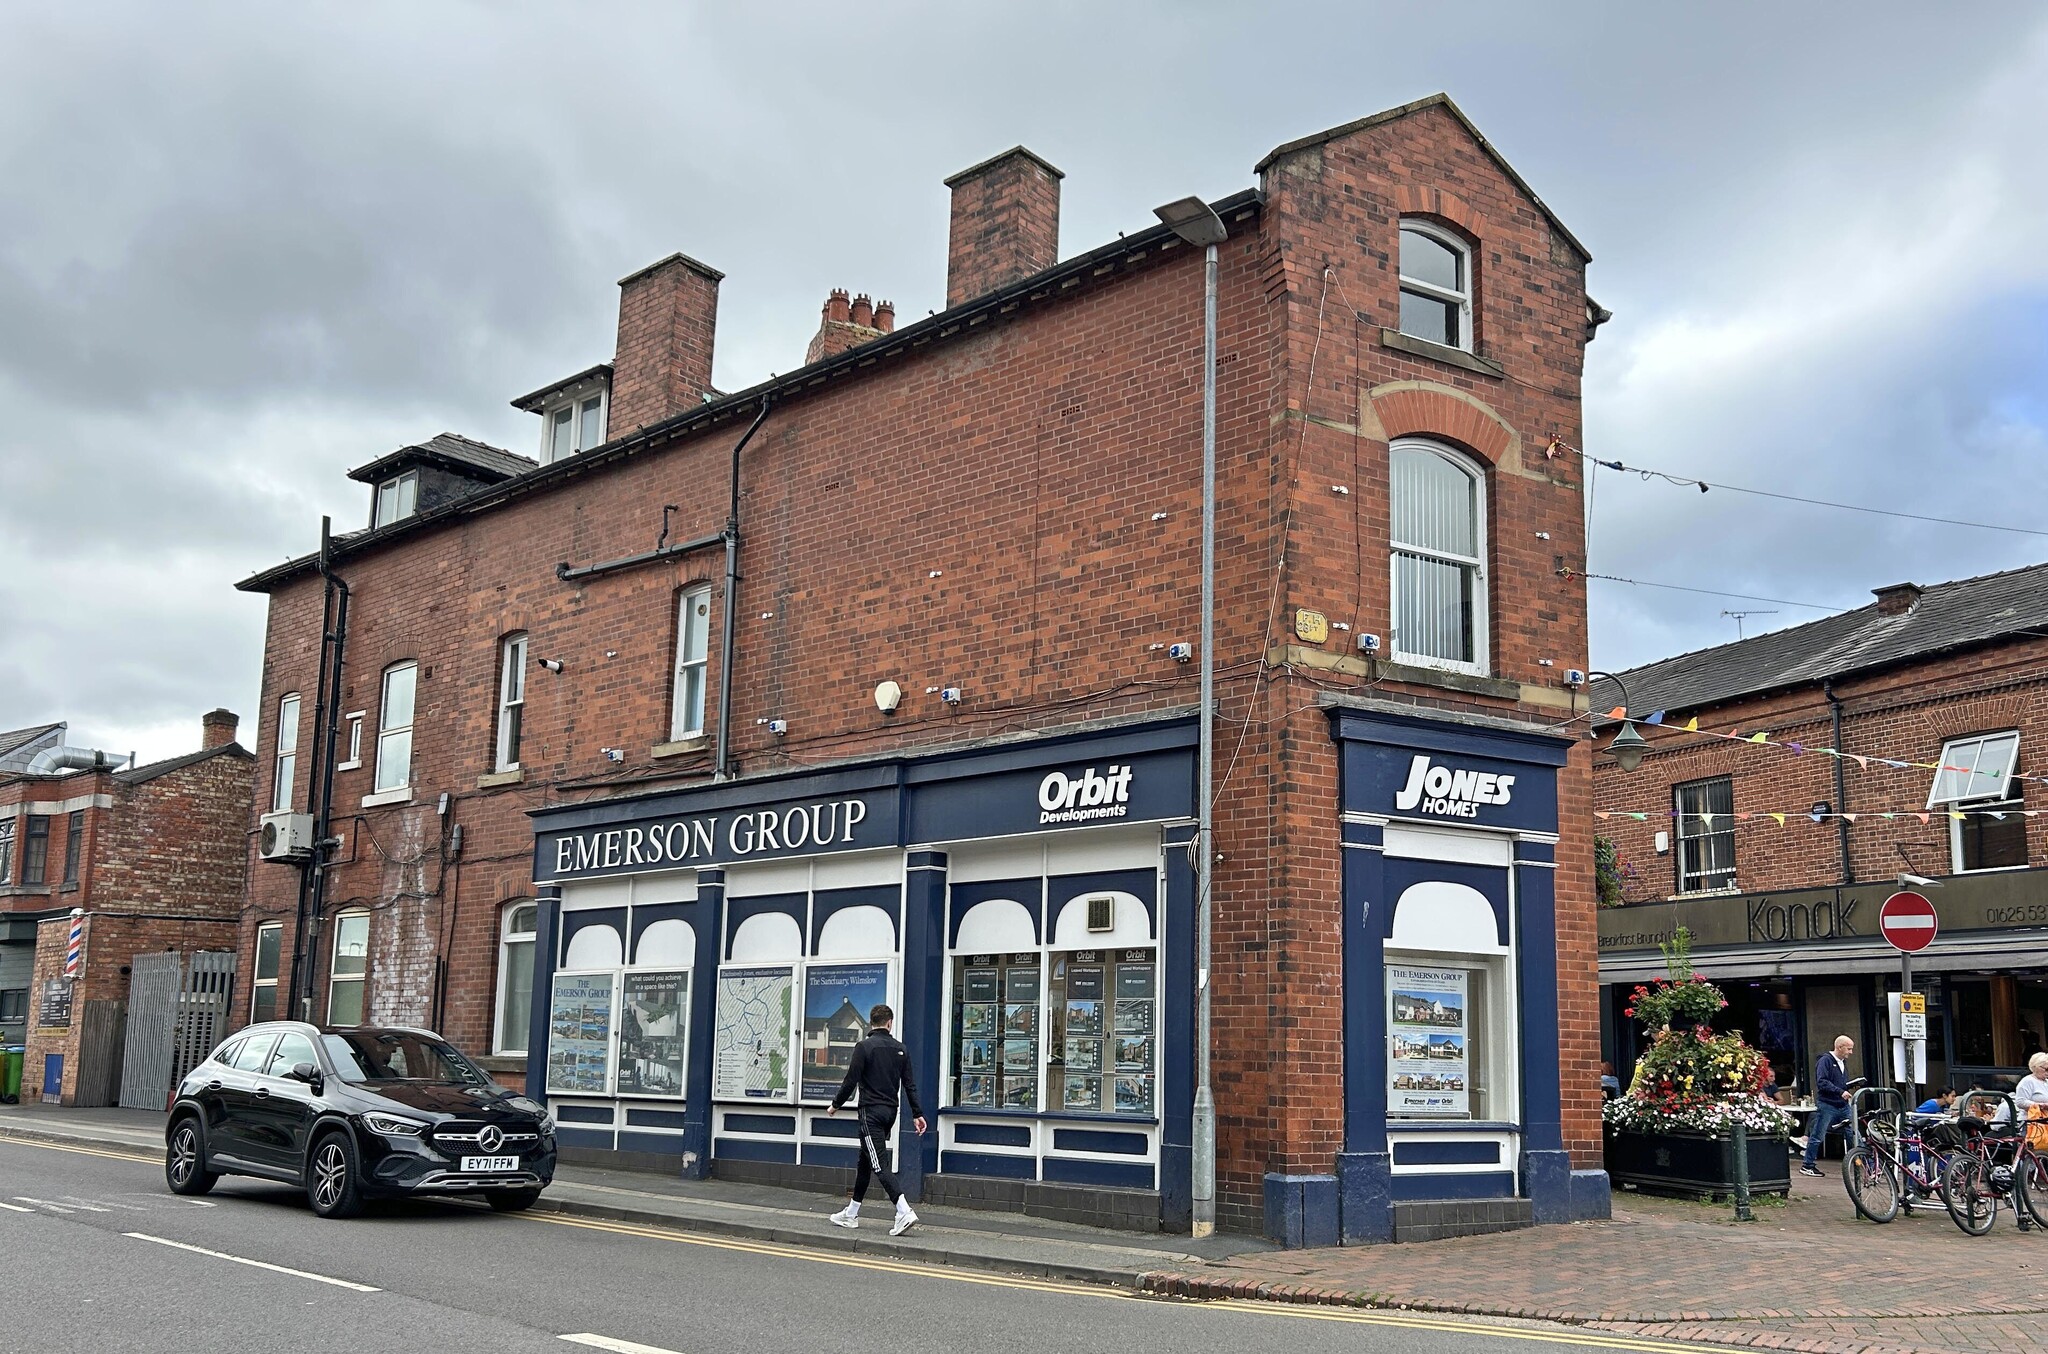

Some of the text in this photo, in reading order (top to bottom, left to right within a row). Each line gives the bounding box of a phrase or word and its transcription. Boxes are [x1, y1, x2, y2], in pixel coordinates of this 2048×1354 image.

[1039, 765, 1132, 811] Orbit
[1396, 755, 1516, 810] JONES
[1040, 804, 1127, 824] Developments
[1422, 797, 1479, 818] HOMES
[554, 800, 866, 873] EMERSON GROUP
[1747, 889, 1857, 941] Konak
[1986, 904, 2048, 923] 01625 53
[1598, 933, 1635, 947] Breakfast
[1636, 931, 1667, 945] Brunch
[1076, 951, 1096, 960] Orbit
[1126, 950, 1146, 959] Orbit
[577, 979, 590, 989] THE
[810, 977, 820, 986] The
[850, 975, 877, 985] Wilmslow
[1392, 970, 1463, 981] THE EMERSON GROUP
[555, 987, 611, 999] EMERSON GROUP
